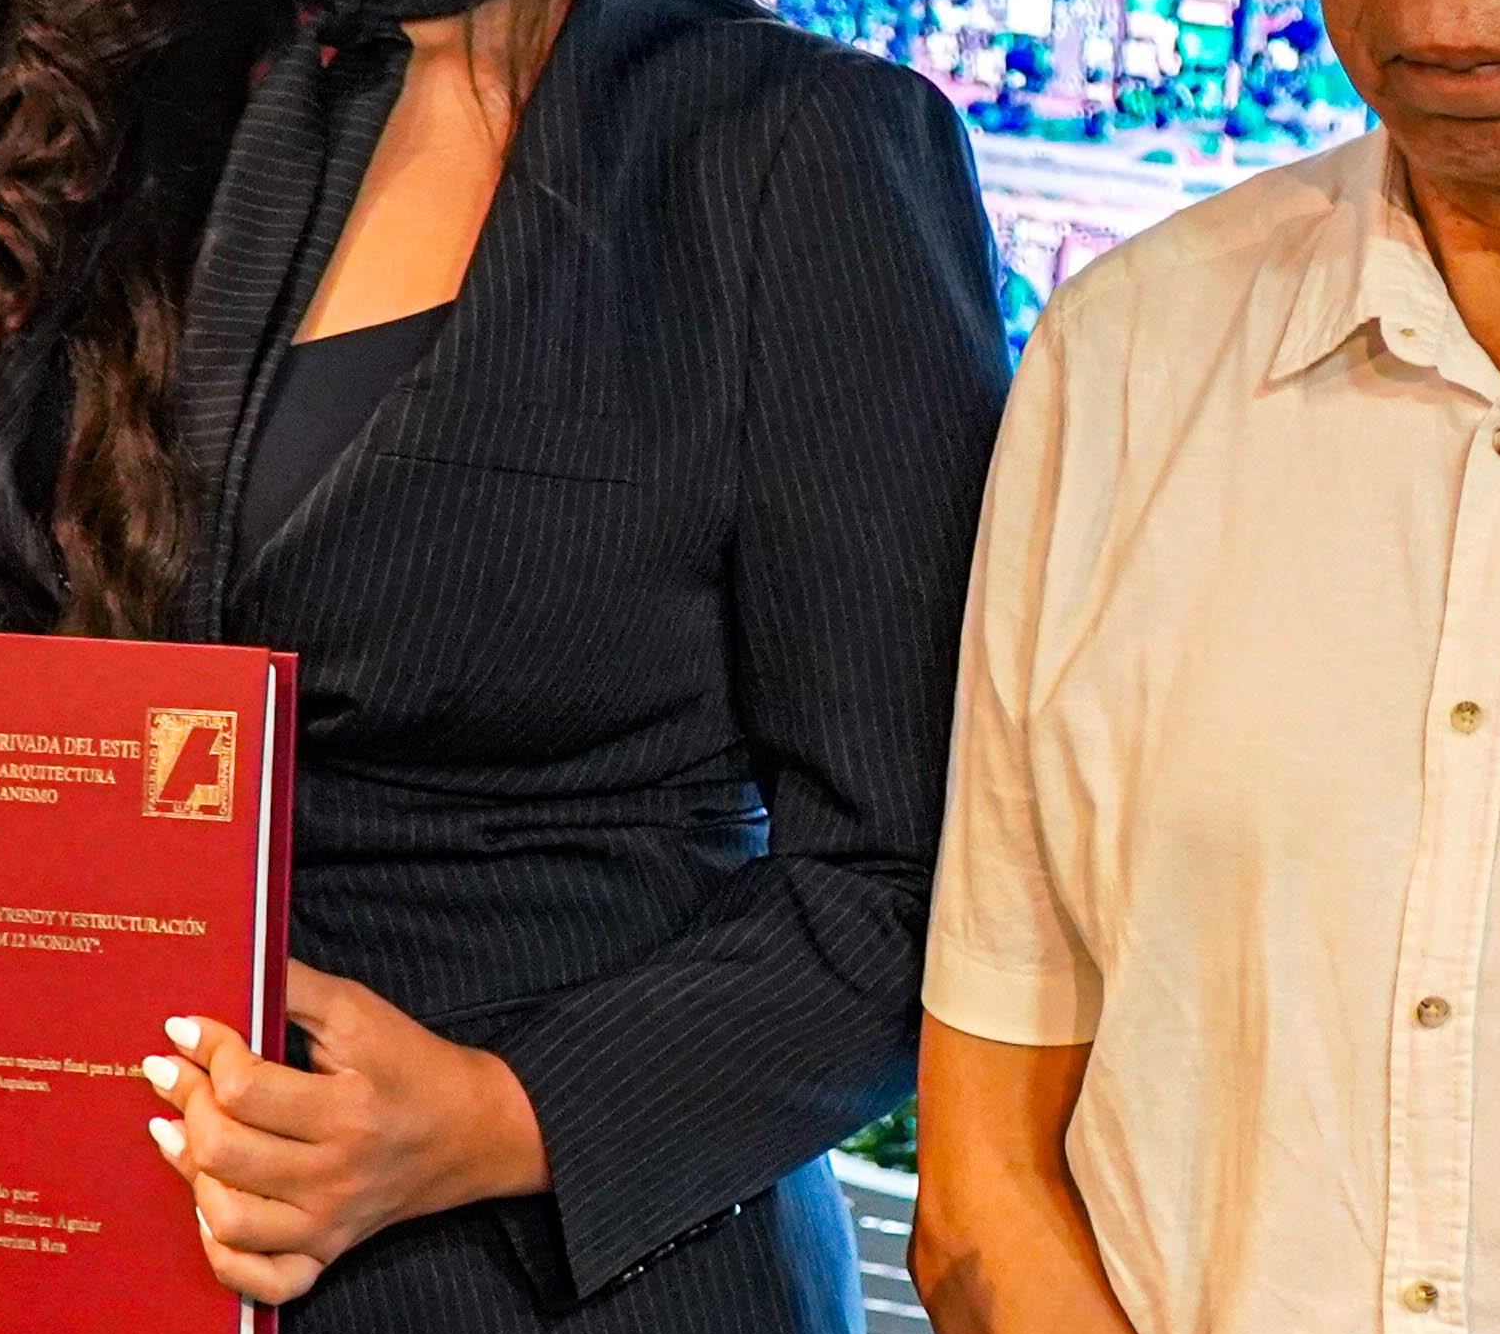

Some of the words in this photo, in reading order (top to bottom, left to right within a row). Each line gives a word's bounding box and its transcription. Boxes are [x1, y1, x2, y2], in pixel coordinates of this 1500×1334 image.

[63, 736, 97, 756] DEL
[99, 738, 141, 759] ESTE
[10, 932, 26, 948] 12
